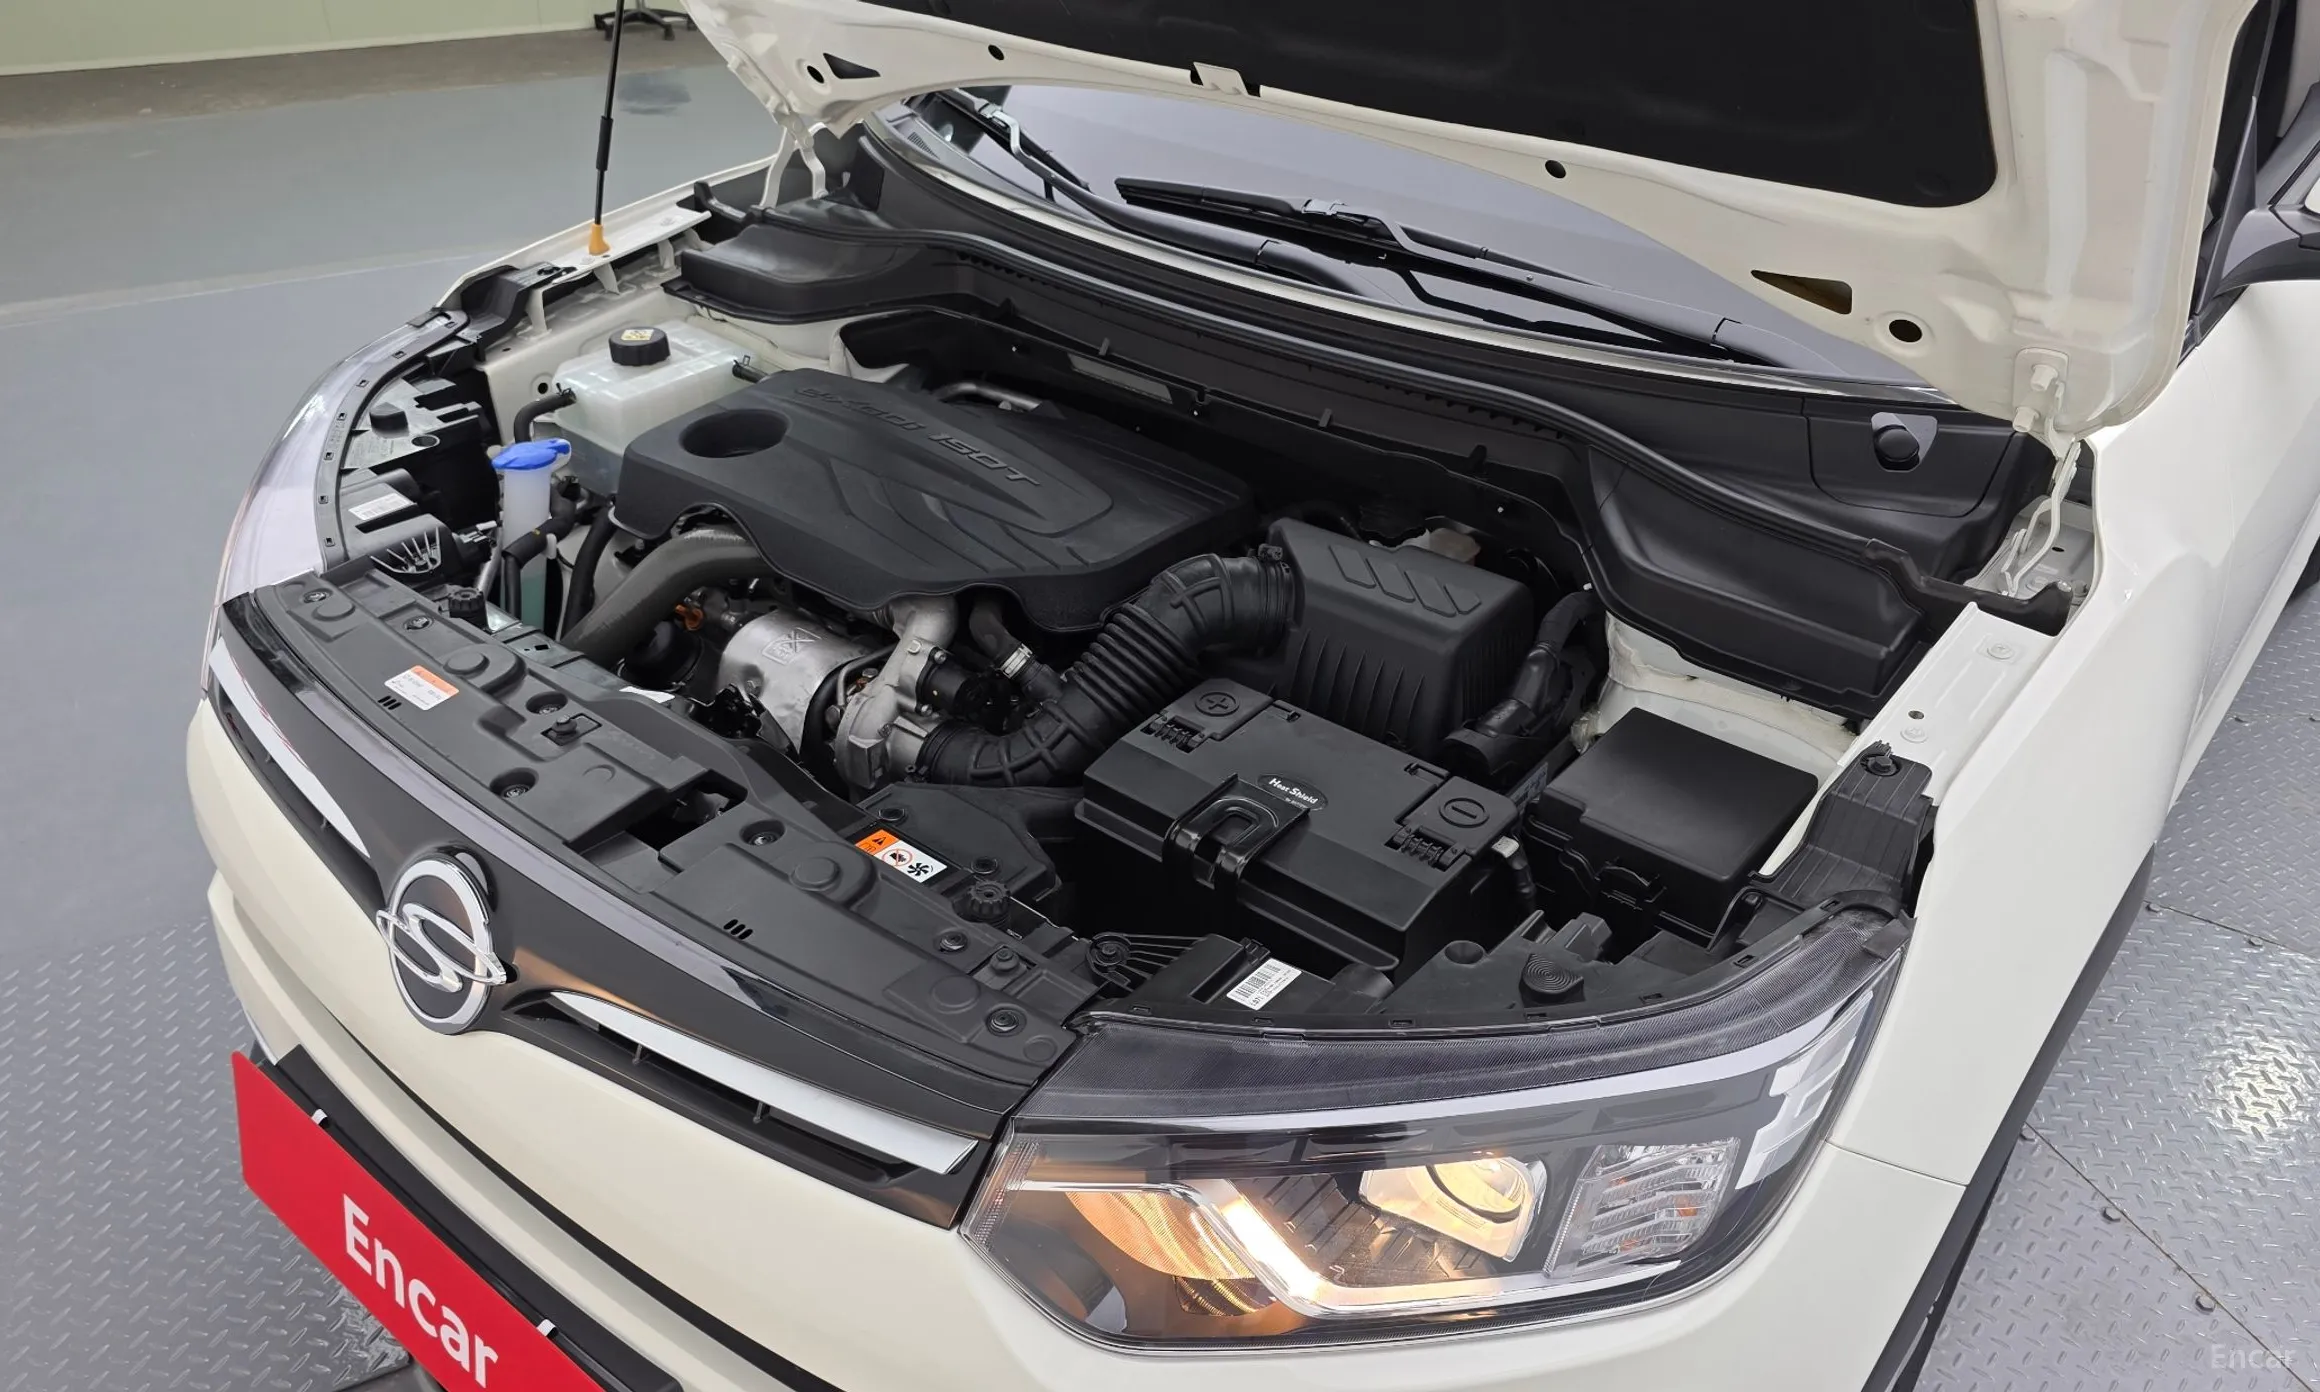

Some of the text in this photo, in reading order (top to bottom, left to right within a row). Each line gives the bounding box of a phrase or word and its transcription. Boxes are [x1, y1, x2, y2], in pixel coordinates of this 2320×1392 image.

[928, 434, 1041, 486] 150T
[1289, 787, 1319, 804] Shield
[343, 1193, 499, 1388] Encar
